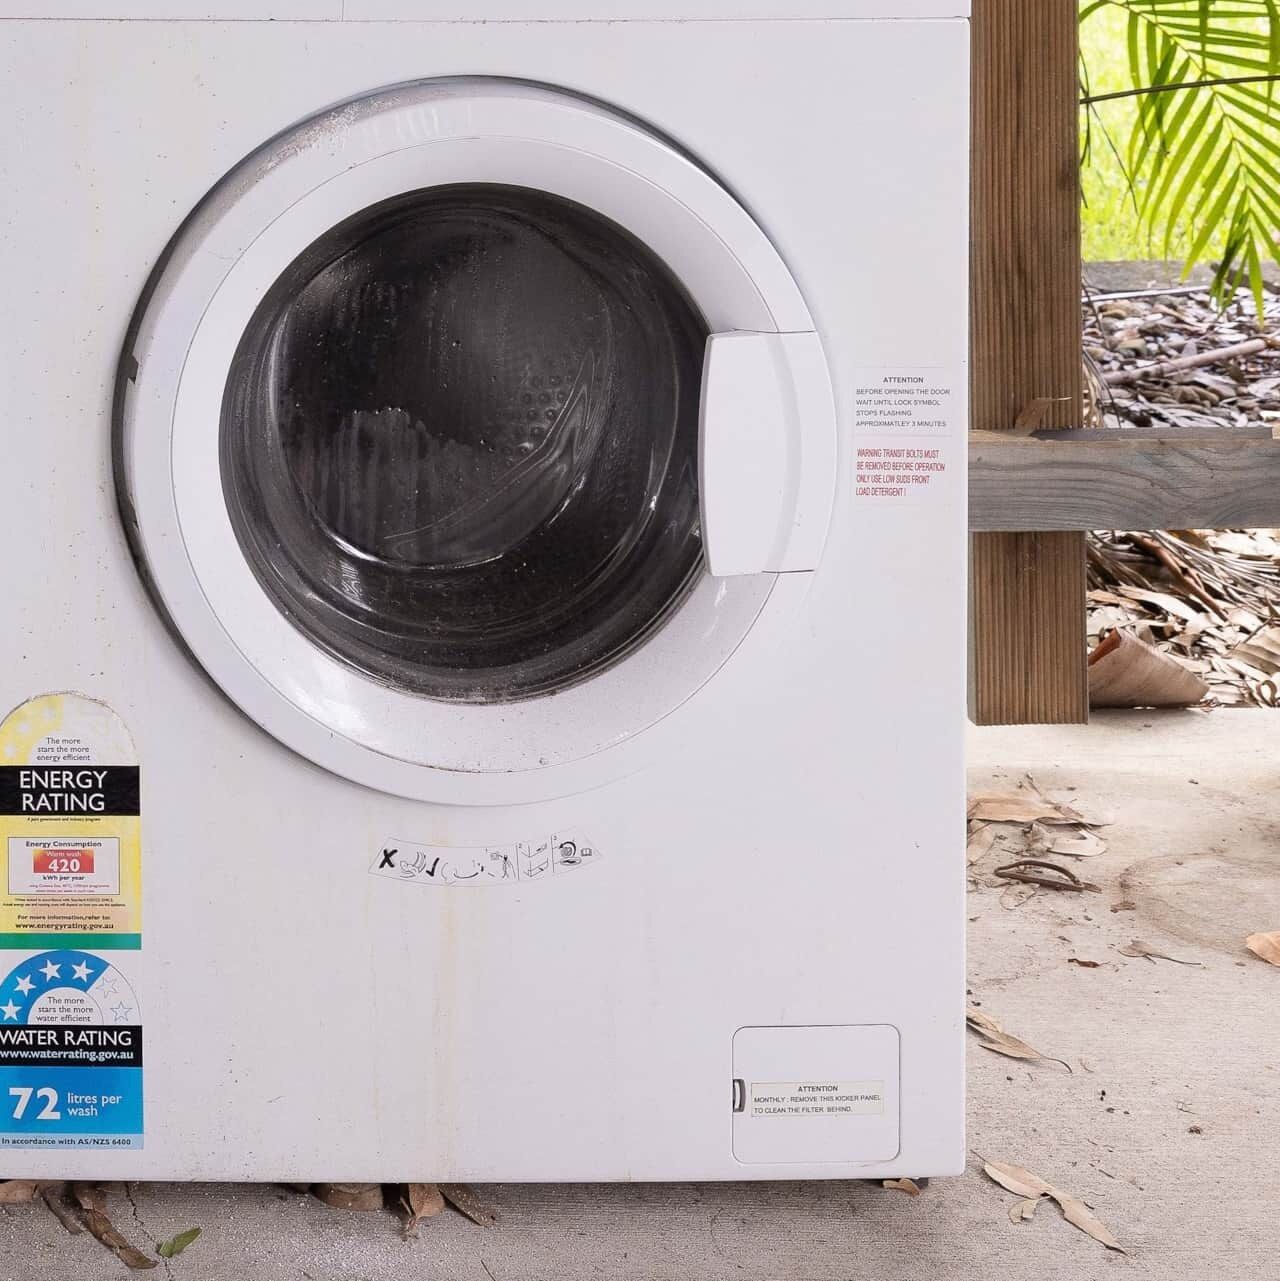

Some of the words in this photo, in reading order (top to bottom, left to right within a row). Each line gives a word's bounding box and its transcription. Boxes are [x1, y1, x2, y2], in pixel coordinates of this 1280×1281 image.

[857, 448, 881, 457] WARNING
[883, 449, 905, 458] TRANSIT
[906, 449, 923, 458] BOLTS
[882, 475, 895, 483] LOW
[871, 488, 903, 496] DETERGENT
[46, 737, 60, 745] The
[20, 770, 107, 789] ENERGY
[22, 793, 105, 811] RATING
[48, 859, 80, 872] 420
[64, 1030, 132, 1046] RATING
[0, 1049, 134, 1061] www.waterrating.gov.au
[9, 1088, 61, 1120] 72
[67, 1092, 97, 1104] litres
[102, 1096, 122, 1107] per
[68, 1106, 98, 1116] wash
